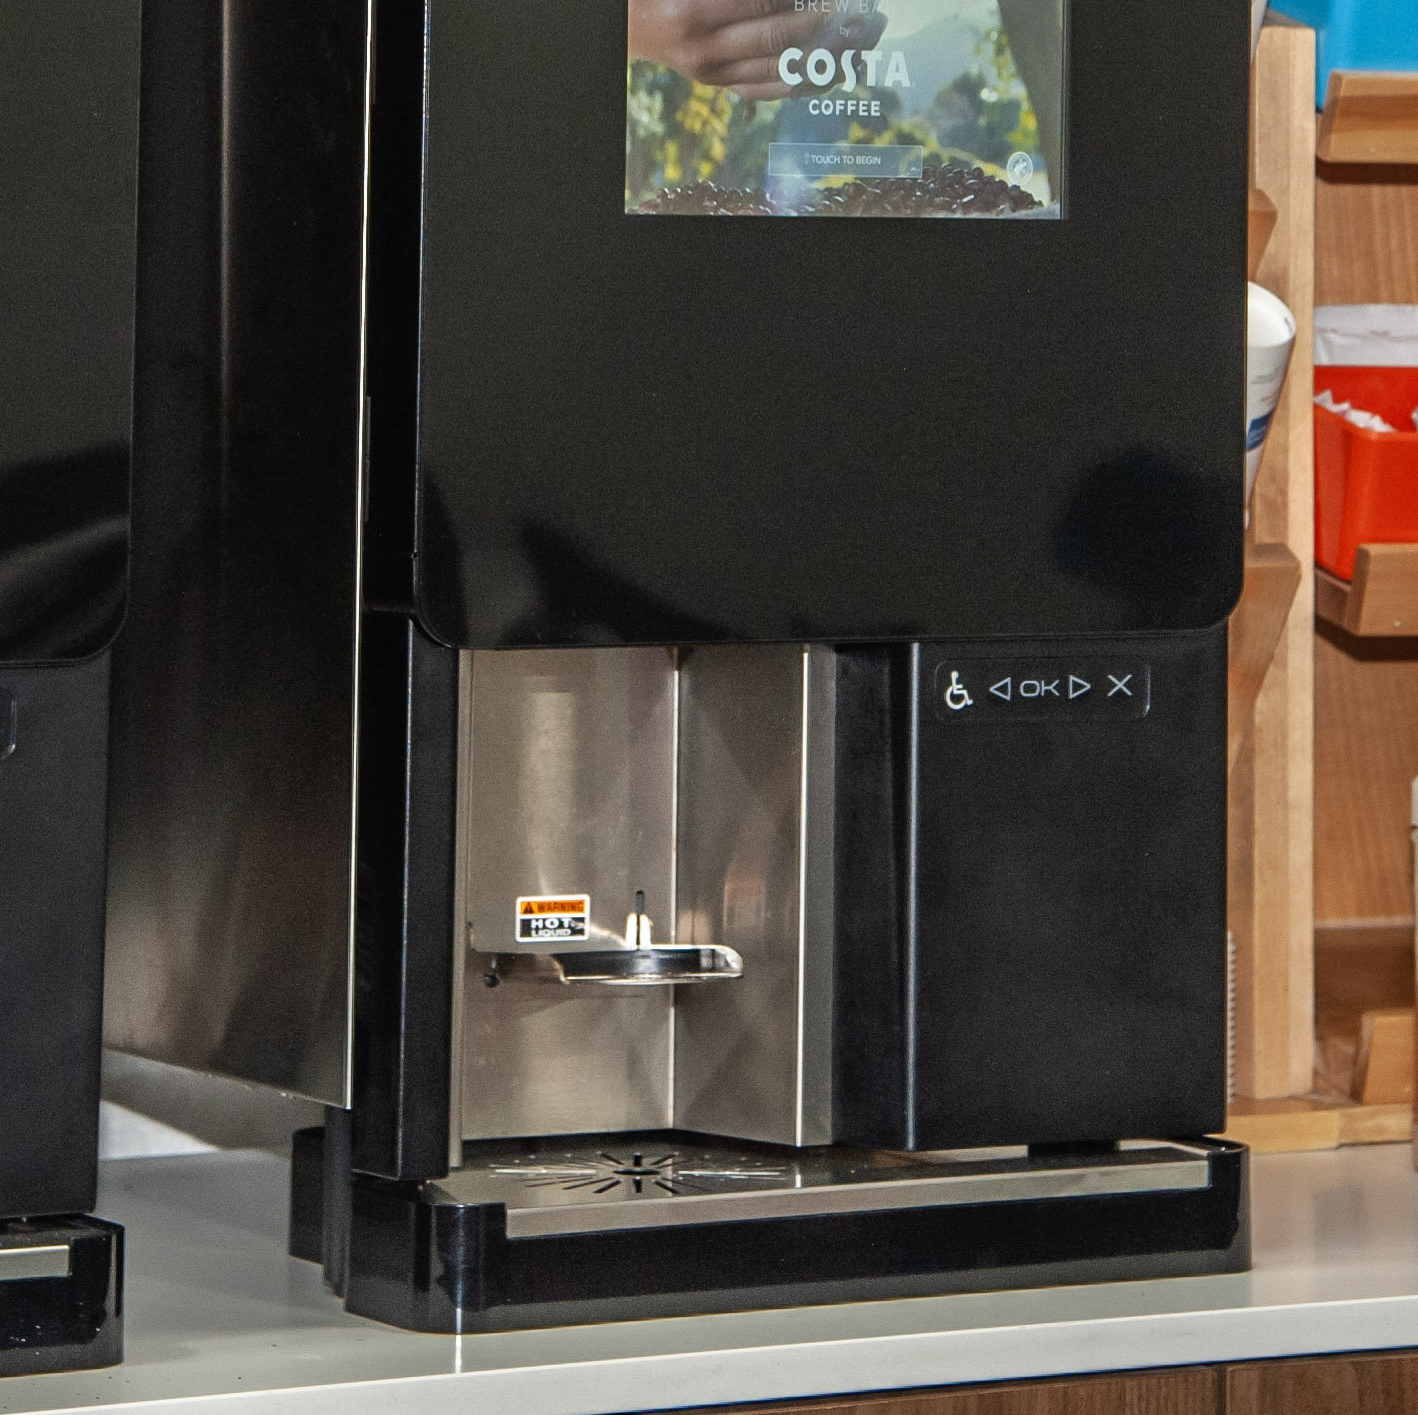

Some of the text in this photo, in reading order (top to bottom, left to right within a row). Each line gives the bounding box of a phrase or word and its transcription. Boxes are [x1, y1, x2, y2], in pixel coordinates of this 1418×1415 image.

[839, 26, 851, 37] by
[778, 47, 911, 93] COSTA
[809, 99, 881, 117] COFFEE
[811, 155, 881, 164] TOUCH TO BEGIN
[1019, 679, 1060, 697] OK
[531, 918, 573, 929] HOT
